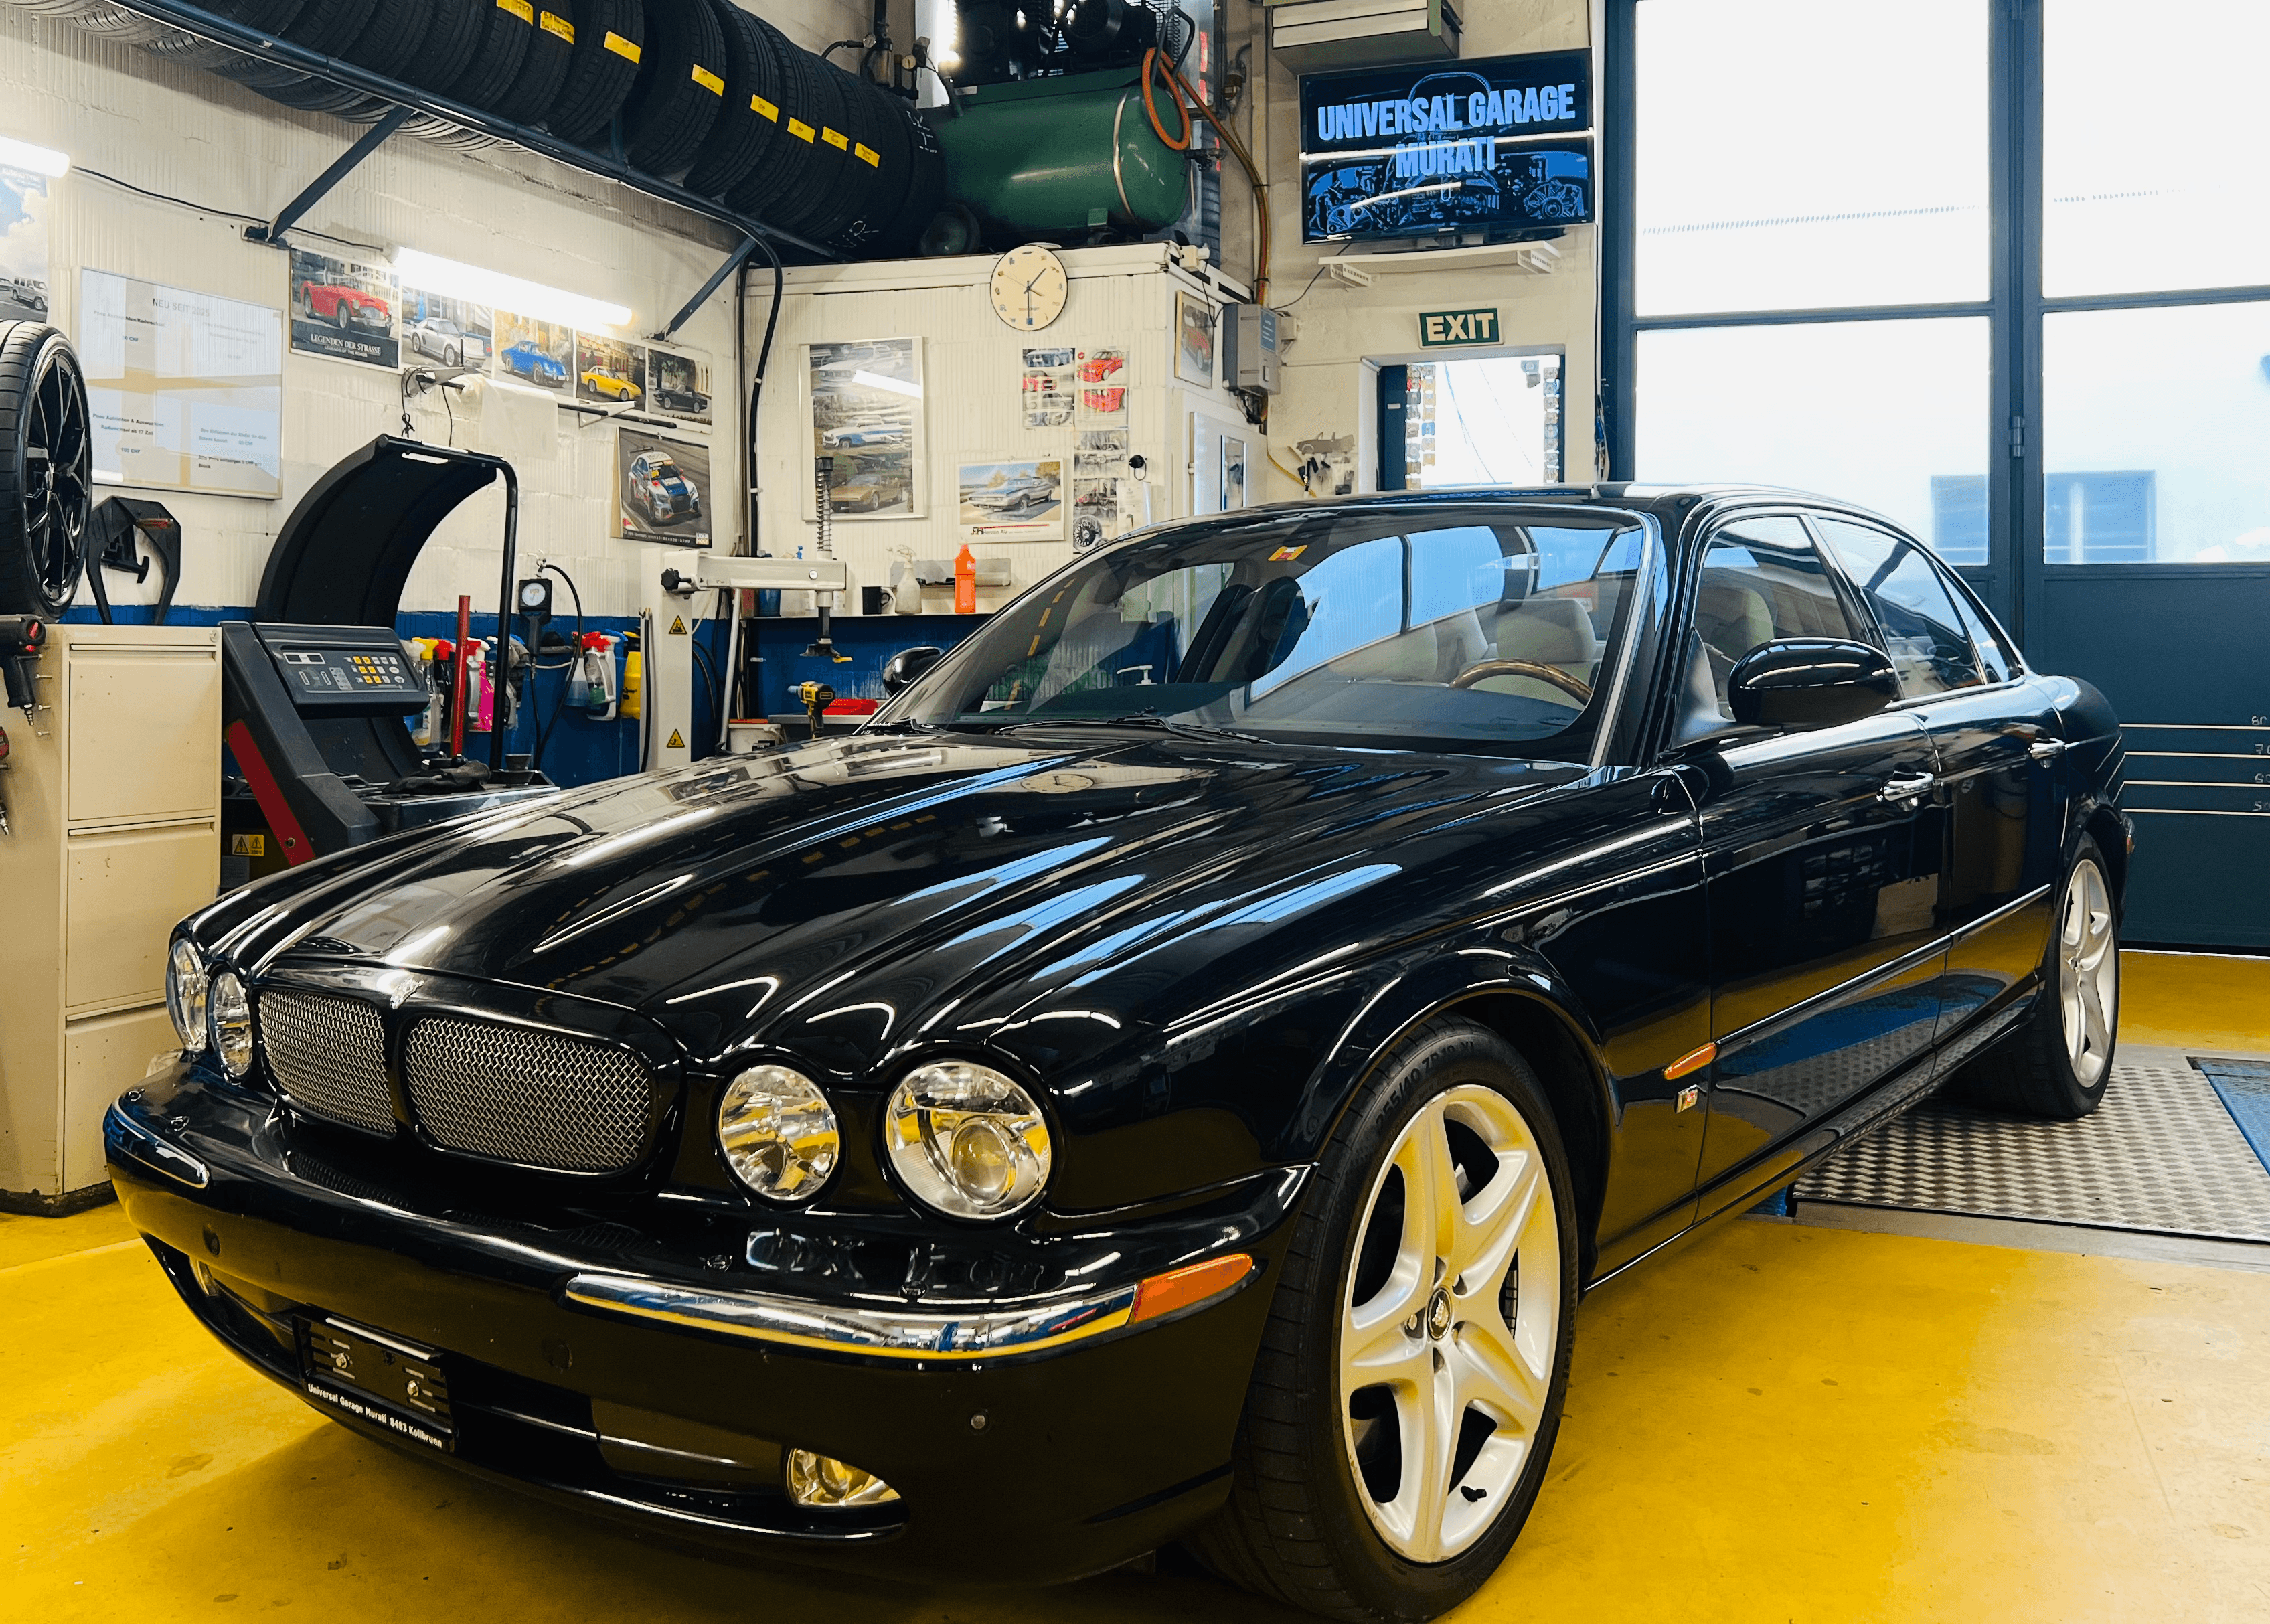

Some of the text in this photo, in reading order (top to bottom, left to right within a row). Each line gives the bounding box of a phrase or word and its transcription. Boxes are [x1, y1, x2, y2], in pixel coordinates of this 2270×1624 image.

[1317, 84, 1576, 141] UNIVERSAL GARAGE
[1395, 136, 1496, 179] MURATI
[153, 298, 210, 317] NEU SEIT 2025
[310, 333, 381, 355] LEGENDEN DER STRASSE
[1425, 311, 1494, 341] EXIT
[308, 1383, 442, 1449] Universal Garage Murati 8483 Kollbrunn
